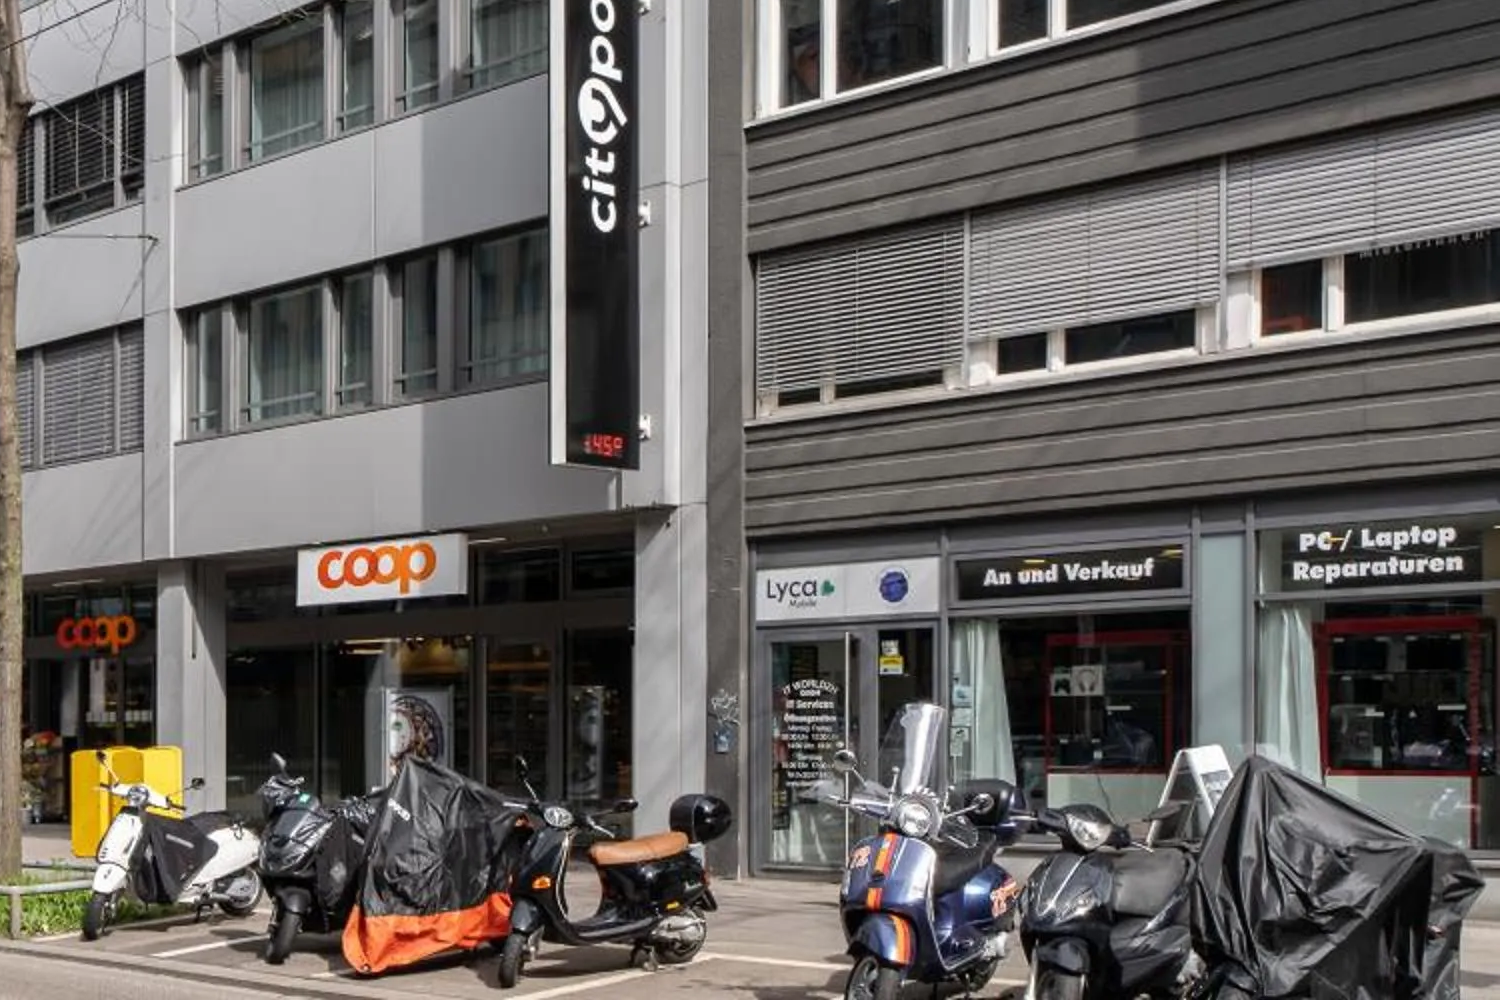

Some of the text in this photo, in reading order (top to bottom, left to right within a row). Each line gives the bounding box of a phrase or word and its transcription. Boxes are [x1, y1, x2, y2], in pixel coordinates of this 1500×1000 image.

[1299, 532, 1333, 552] PC
[1361, 526, 1457, 549] Laptop
[317, 542, 437, 594] coop
[984, 557, 1154, 586] An und Verkauf
[1293, 555, 1463, 583] Reparaturen
[767, 579, 817, 602] Lyca
[56, 615, 135, 655] coop
